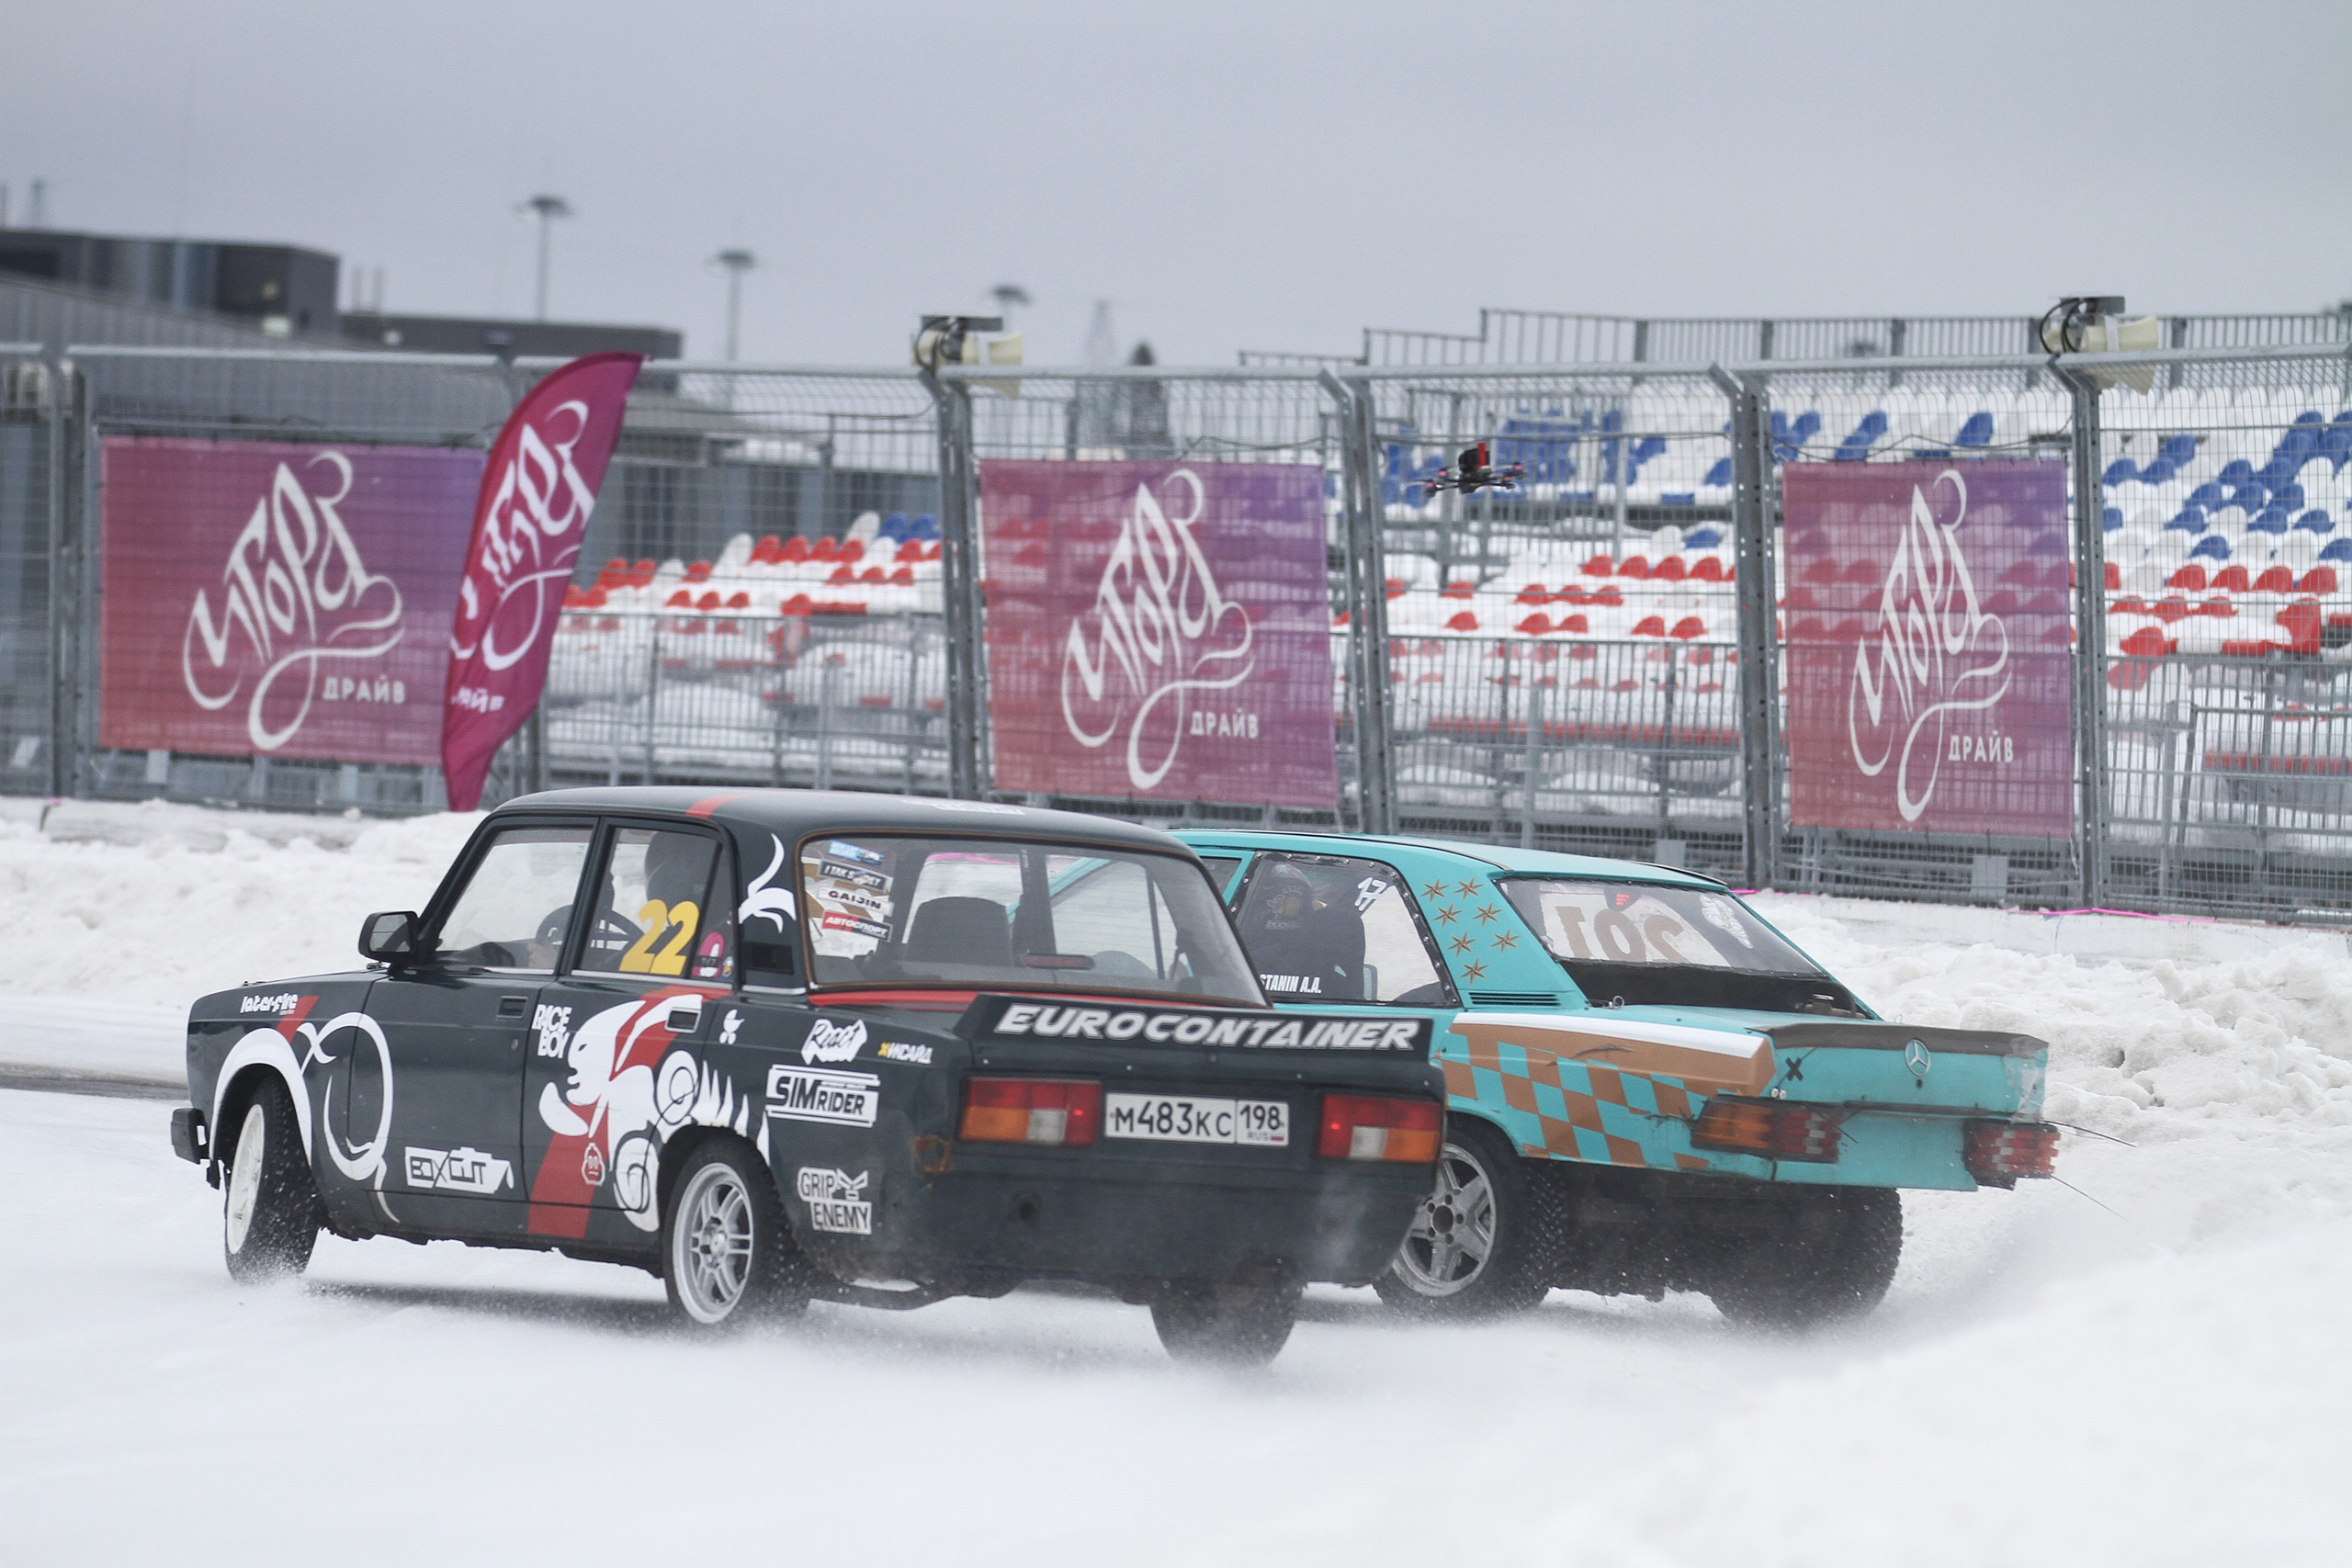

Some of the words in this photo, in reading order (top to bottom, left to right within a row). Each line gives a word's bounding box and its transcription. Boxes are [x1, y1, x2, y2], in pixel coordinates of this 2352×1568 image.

[322, 673, 406, 705] ДРАЙВ
[1190, 708, 1260, 739] ДРАЙВ
[1948, 731, 2014, 764] ДРАЙВ
[828, 890, 881, 909] GAIJIN
[1354, 877, 1387, 911] 17
[617, 898, 700, 976] 22
[1299, 976, 1322, 994] A.A.
[993, 1002, 1420, 1051] EUROCONTAINER
[537, 1030, 571, 1058] BOY
[1239, 1104, 1281, 1131] 198
[801, 1172, 835, 1198] GRIP
[813, 1201, 867, 1229] ENEMY
